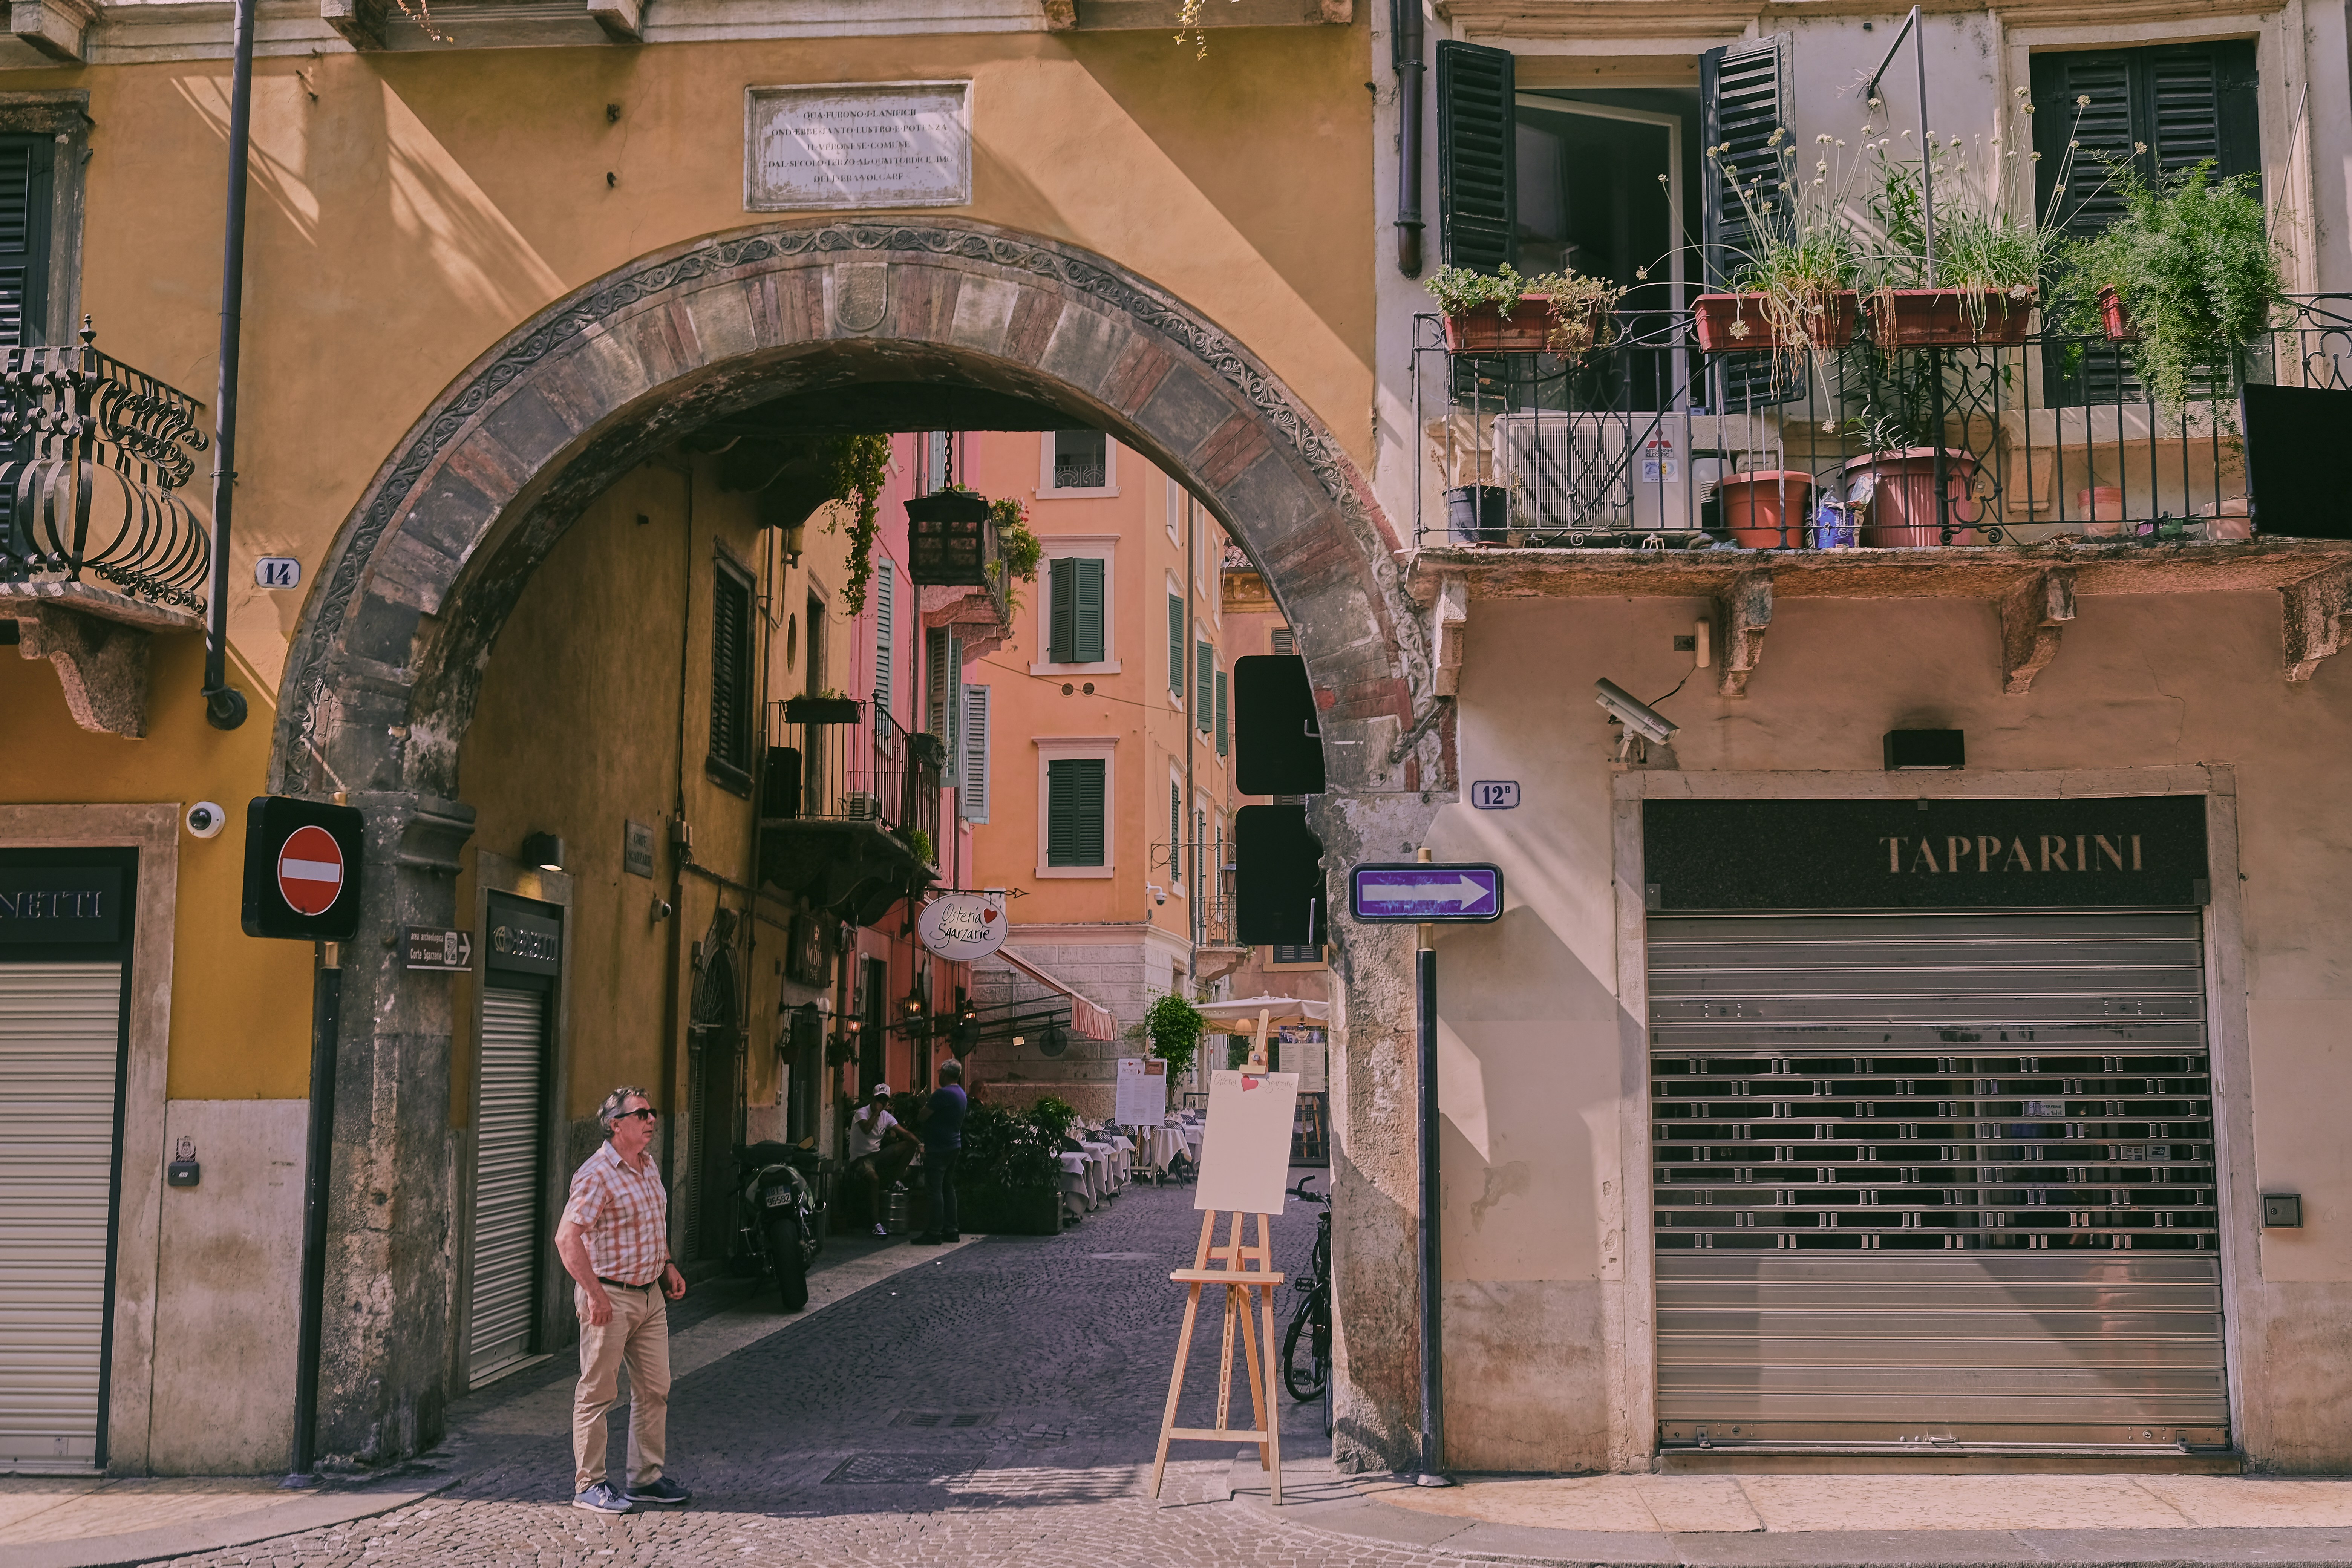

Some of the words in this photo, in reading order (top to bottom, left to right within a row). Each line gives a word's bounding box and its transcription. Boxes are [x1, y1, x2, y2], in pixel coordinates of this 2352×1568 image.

[826, 111, 864, 119] FURONO
[821, 127, 853, 135] TANTO
[857, 126, 892, 134] LUSTRO
[904, 124, 947, 133] POTENZA
[819, 142, 867, 151] VERONESE
[871, 141, 910, 150] COMUNE
[861, 172, 903, 181] VOLGARE
[264, 563, 290, 585] 14
[1879, 834, 2142, 873] TAPPARINI
[942, 903, 993, 928] Osteria
[421, 932, 444, 943] archeologica
[929, 923, 996, 949] Sgarzarie
[410, 948, 422, 960] Corte
[424, 948, 443, 962] Sgarzerie
[806, 941, 822, 968] Nobis
[1214, 1073, 1238, 1088] Osteria
[1259, 1076, 1294, 1093] Sgarzarie
[767, 1194, 790, 1206] 96582
